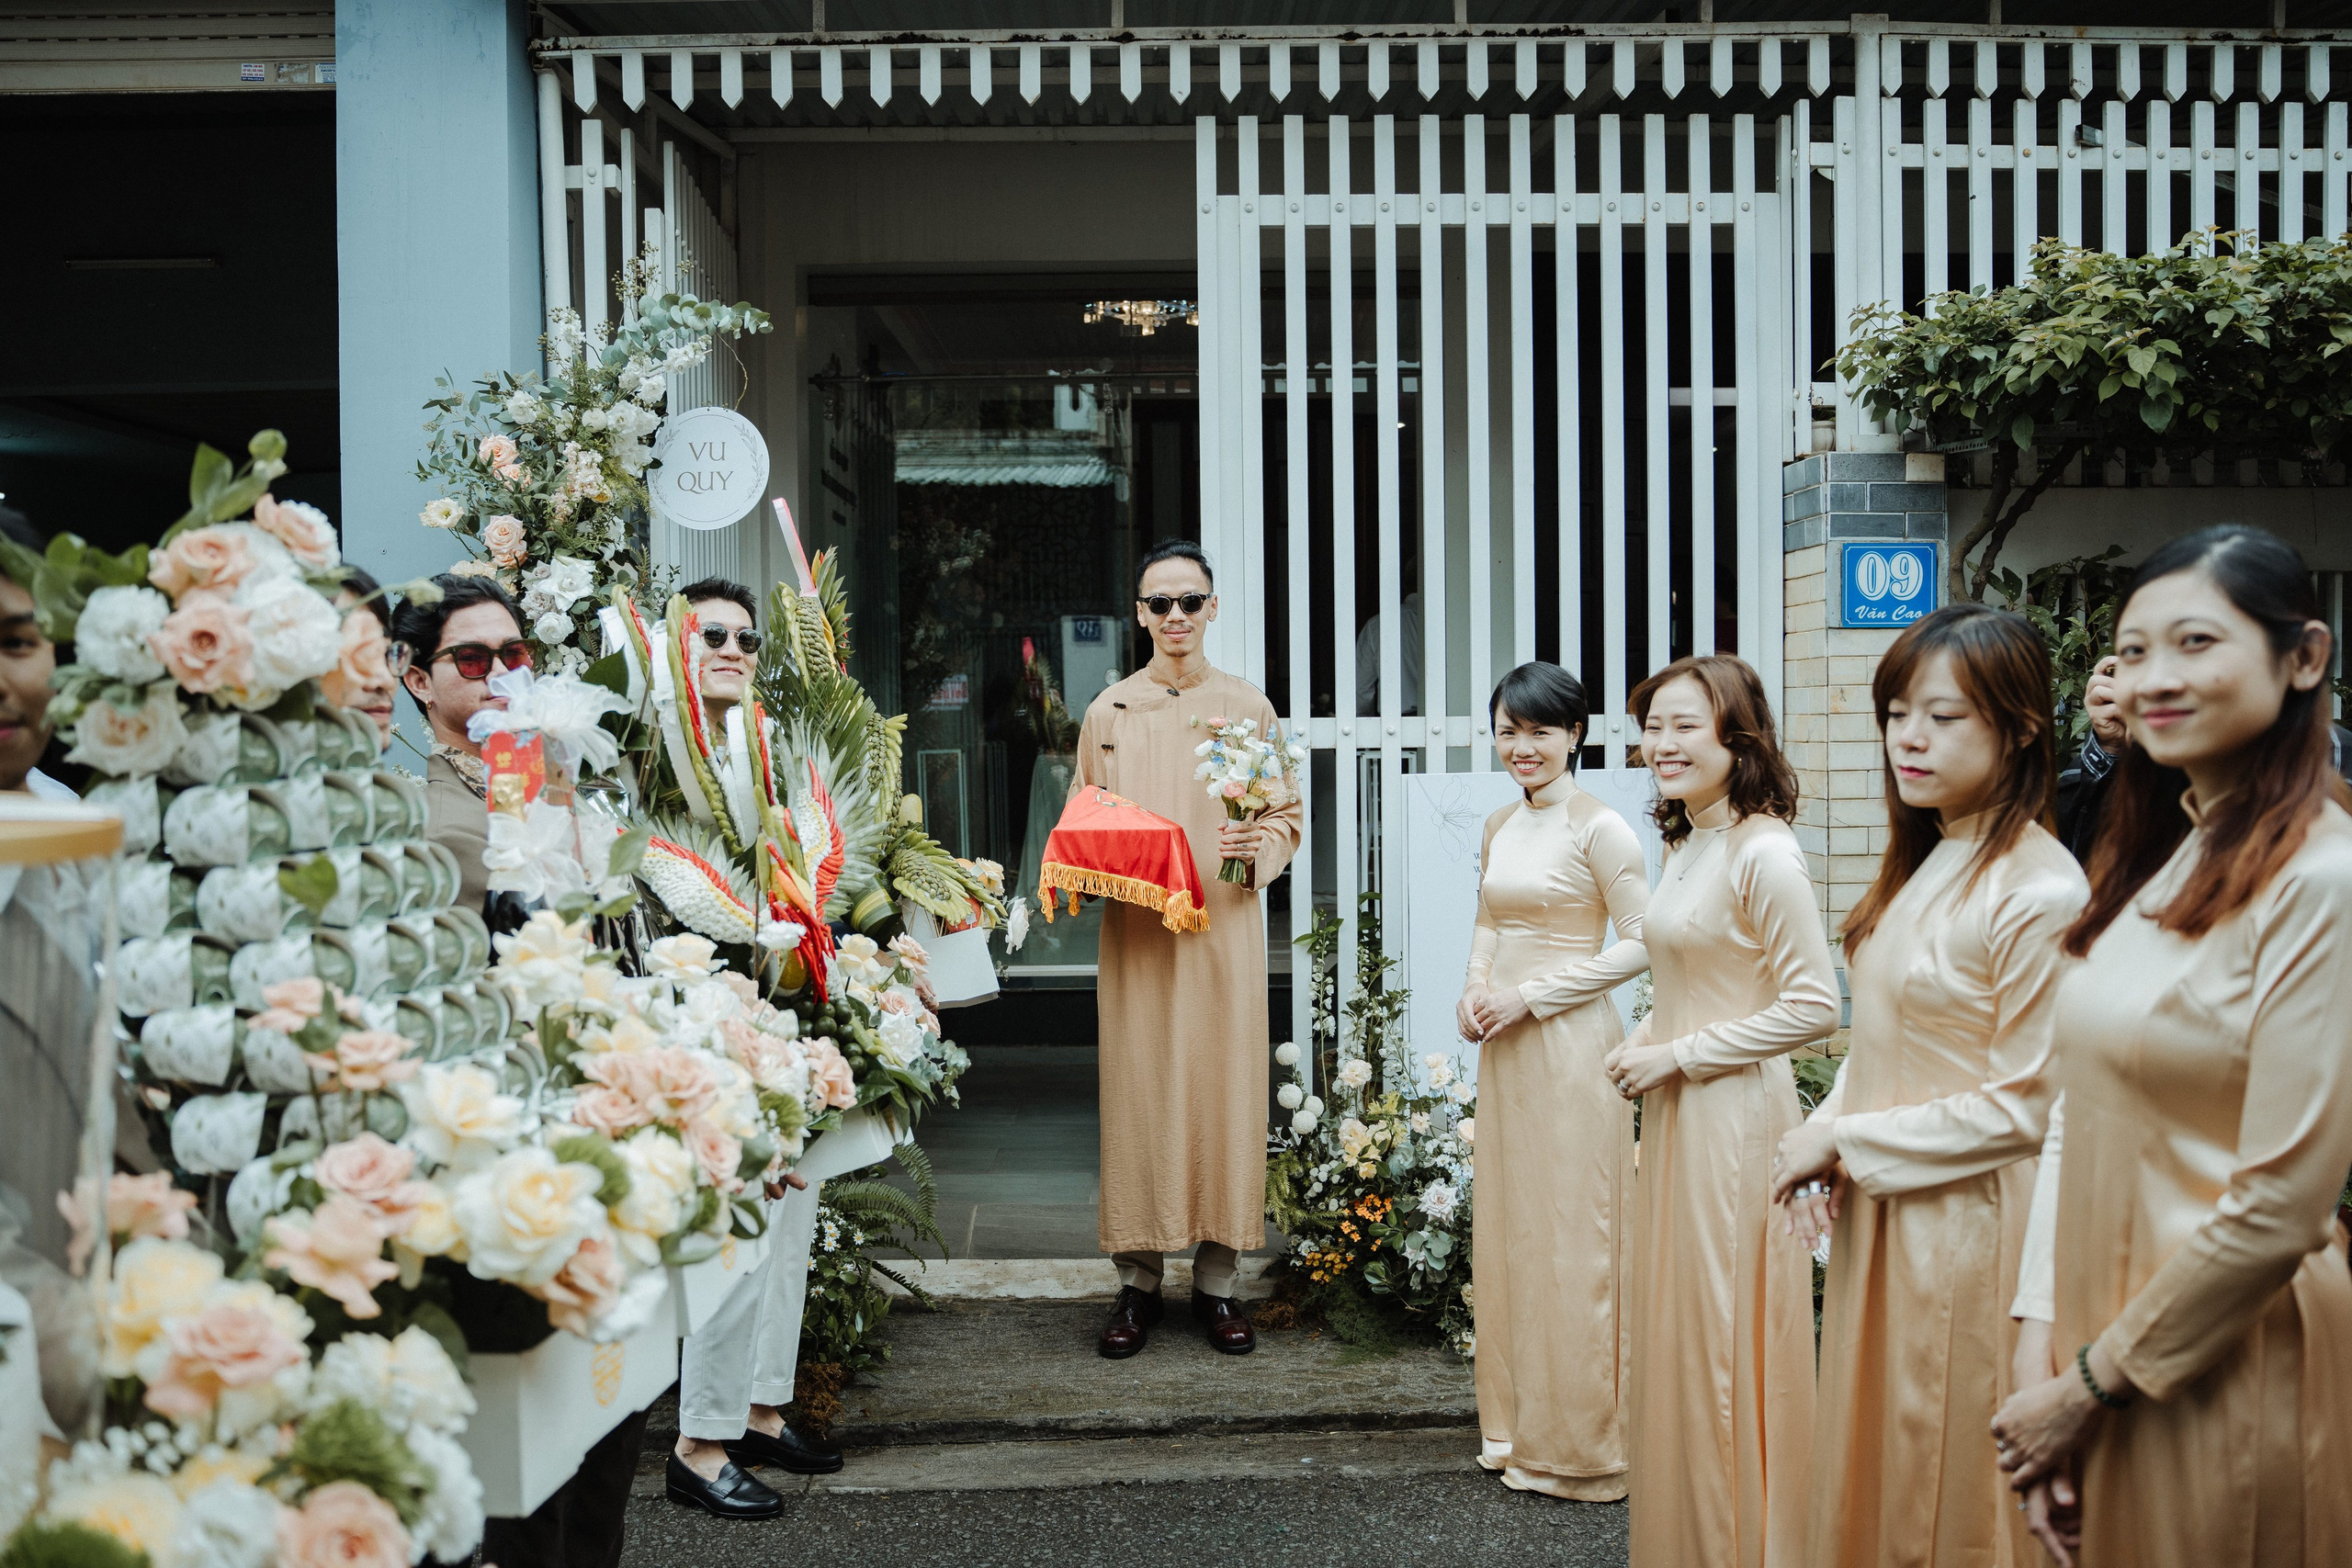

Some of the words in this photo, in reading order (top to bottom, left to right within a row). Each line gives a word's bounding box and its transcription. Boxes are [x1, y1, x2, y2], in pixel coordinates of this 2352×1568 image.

[688, 441, 726, 461] VU
[676, 470, 734, 495] QUY
[1855, 551, 1923, 601] 09
[1855, 605, 1886, 619] Văn
[1892, 605, 1923, 621] Cao
